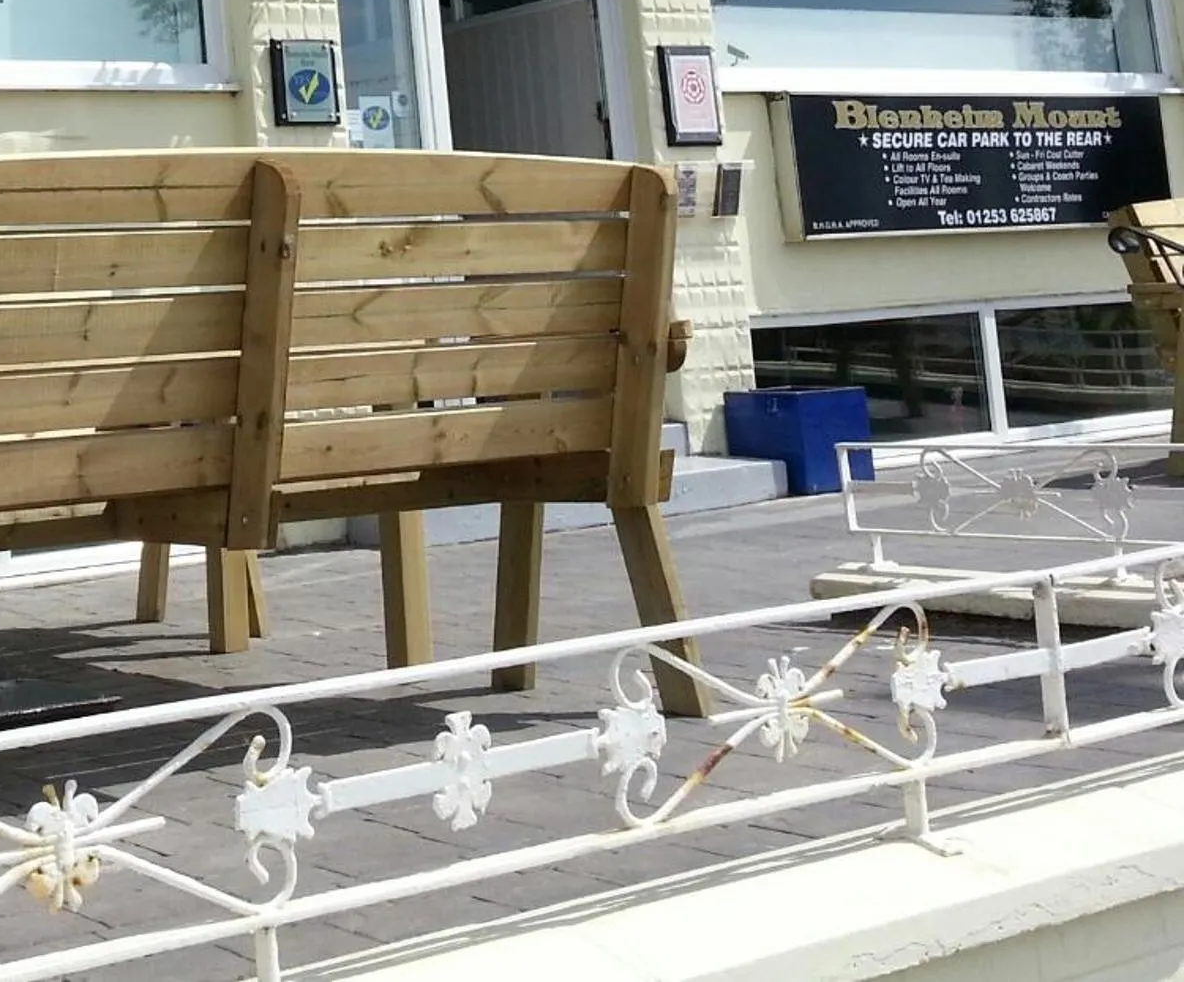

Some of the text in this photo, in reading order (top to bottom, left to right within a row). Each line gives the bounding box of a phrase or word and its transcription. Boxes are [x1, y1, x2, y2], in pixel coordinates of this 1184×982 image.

[832, 100, 1122, 129] Blenheim Mount
[872, 130, 1102, 148] SECURE CAR PARK TO THE REAR
[903, 151, 929, 161] Rooms
[927, 162, 951, 172] Floors
[920, 174, 931, 183] TV
[896, 197, 916, 209] Open
[930, 197, 947, 206] Year
[937, 207, 1056, 226] Tel: 01253 625867
